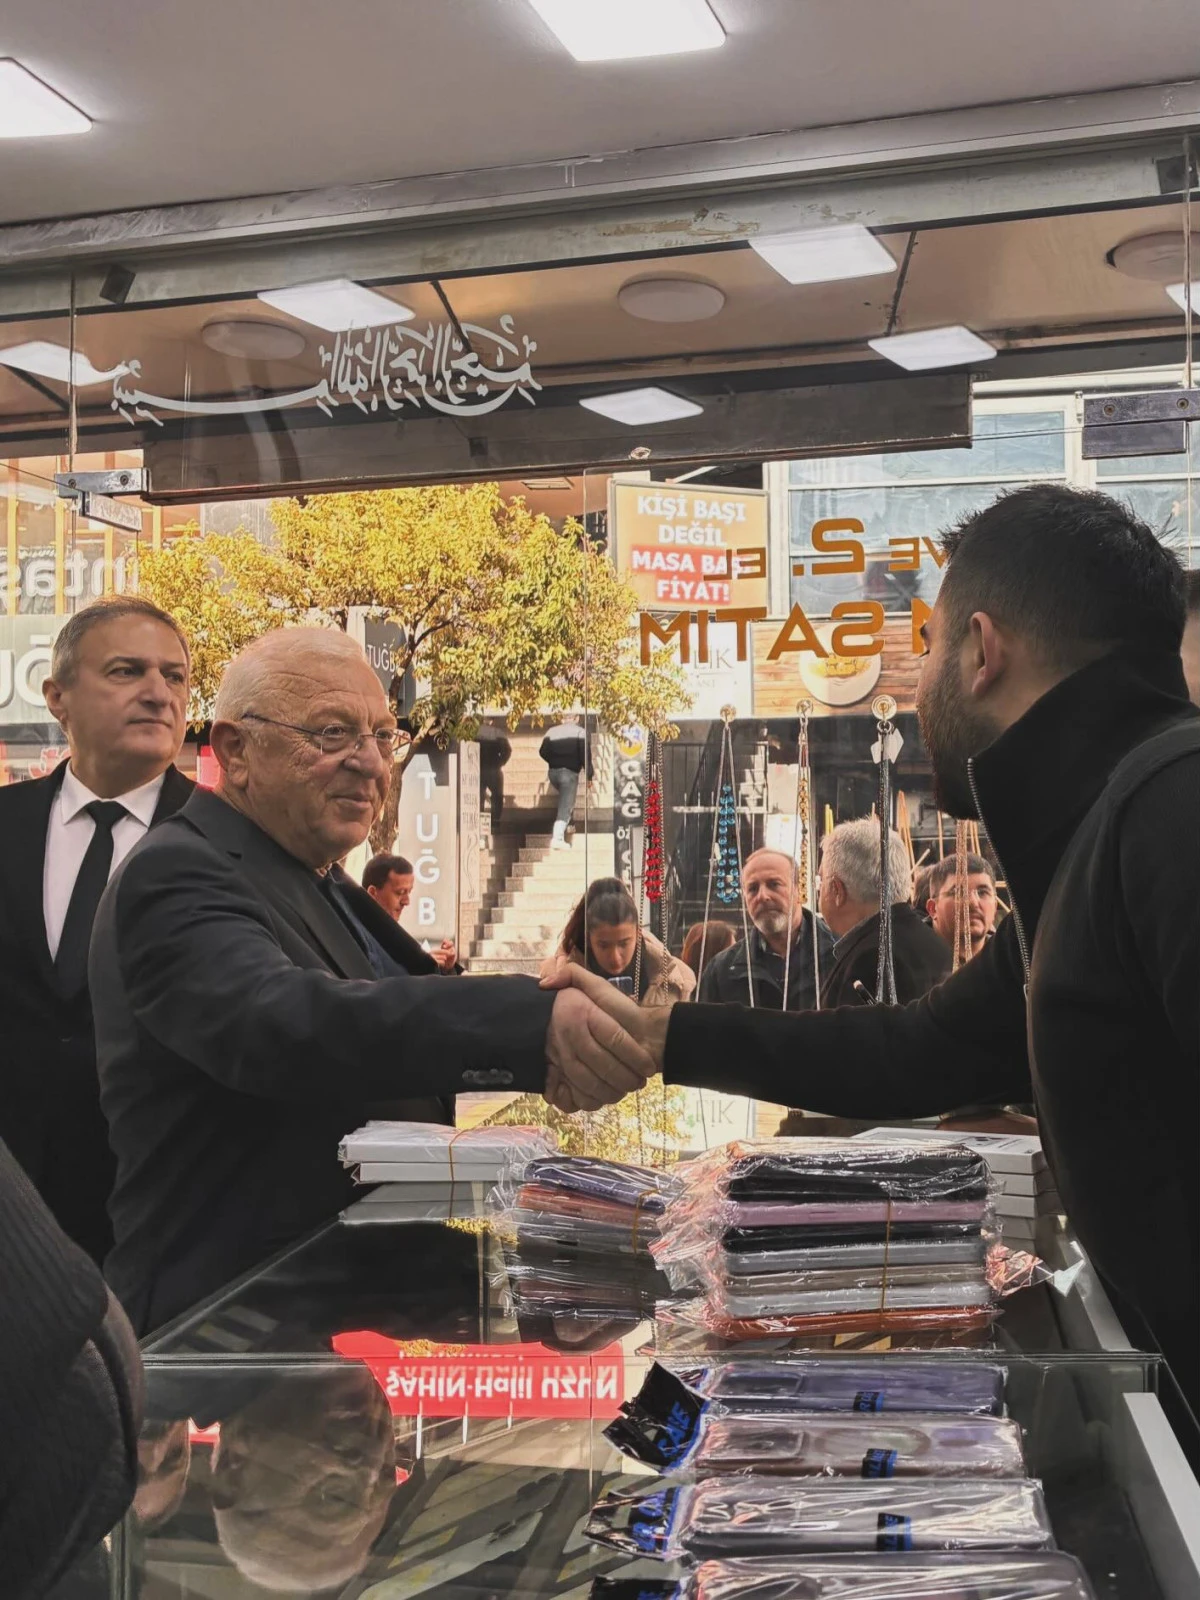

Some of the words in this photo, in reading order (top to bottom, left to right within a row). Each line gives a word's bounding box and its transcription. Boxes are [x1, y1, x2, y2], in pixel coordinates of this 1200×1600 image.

[637, 493, 688, 521] KİŞİ
[694, 499, 746, 525] BAŞI
[658, 520, 727, 546] DEĞİL
[632, 550, 695, 573] MASA
[656, 575, 730, 601] FİYAT!
